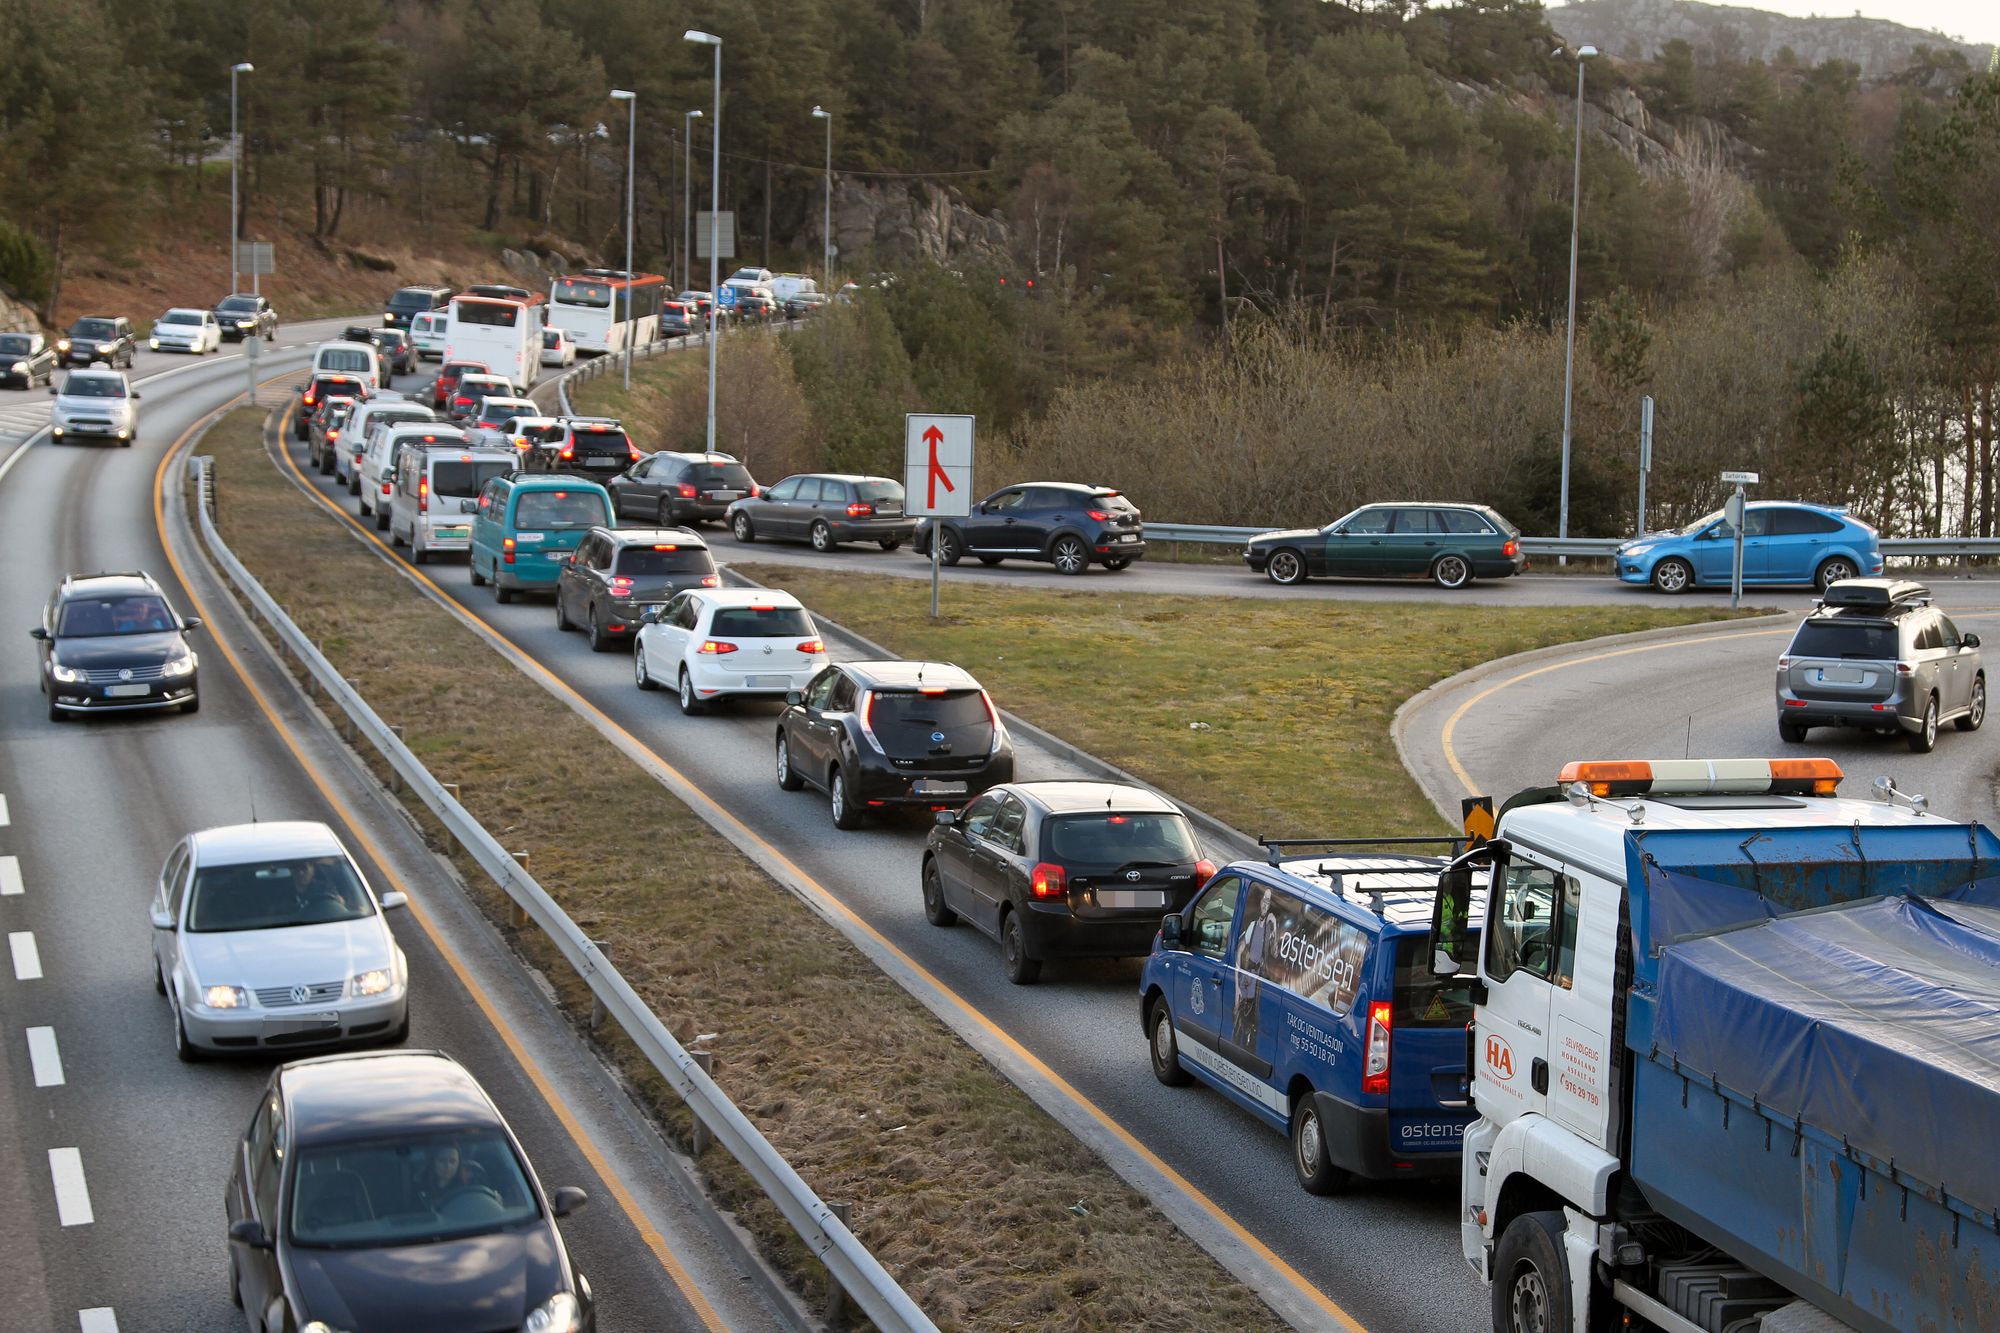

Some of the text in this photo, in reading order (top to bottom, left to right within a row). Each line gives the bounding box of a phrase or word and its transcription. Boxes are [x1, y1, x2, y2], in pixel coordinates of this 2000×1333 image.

[1280, 931, 1354, 991] østensen
[1287, 1012, 1298, 1028] TAK
[1305, 1022, 1344, 1053] VENTILASJON
[1301, 1037, 1309, 1051] 55
[1309, 1042, 1318, 1056] 50
[1318, 1047, 1326, 1061] 18
[1327, 1051, 1336, 1066] 70
[1487, 1038, 1513, 1075] HA
[1561, 1050, 1596, 1073] HORDALAND
[1567, 1065, 1595, 1086] ASFALT AS
[1565, 1079, 1599, 1106] 976 29 790
